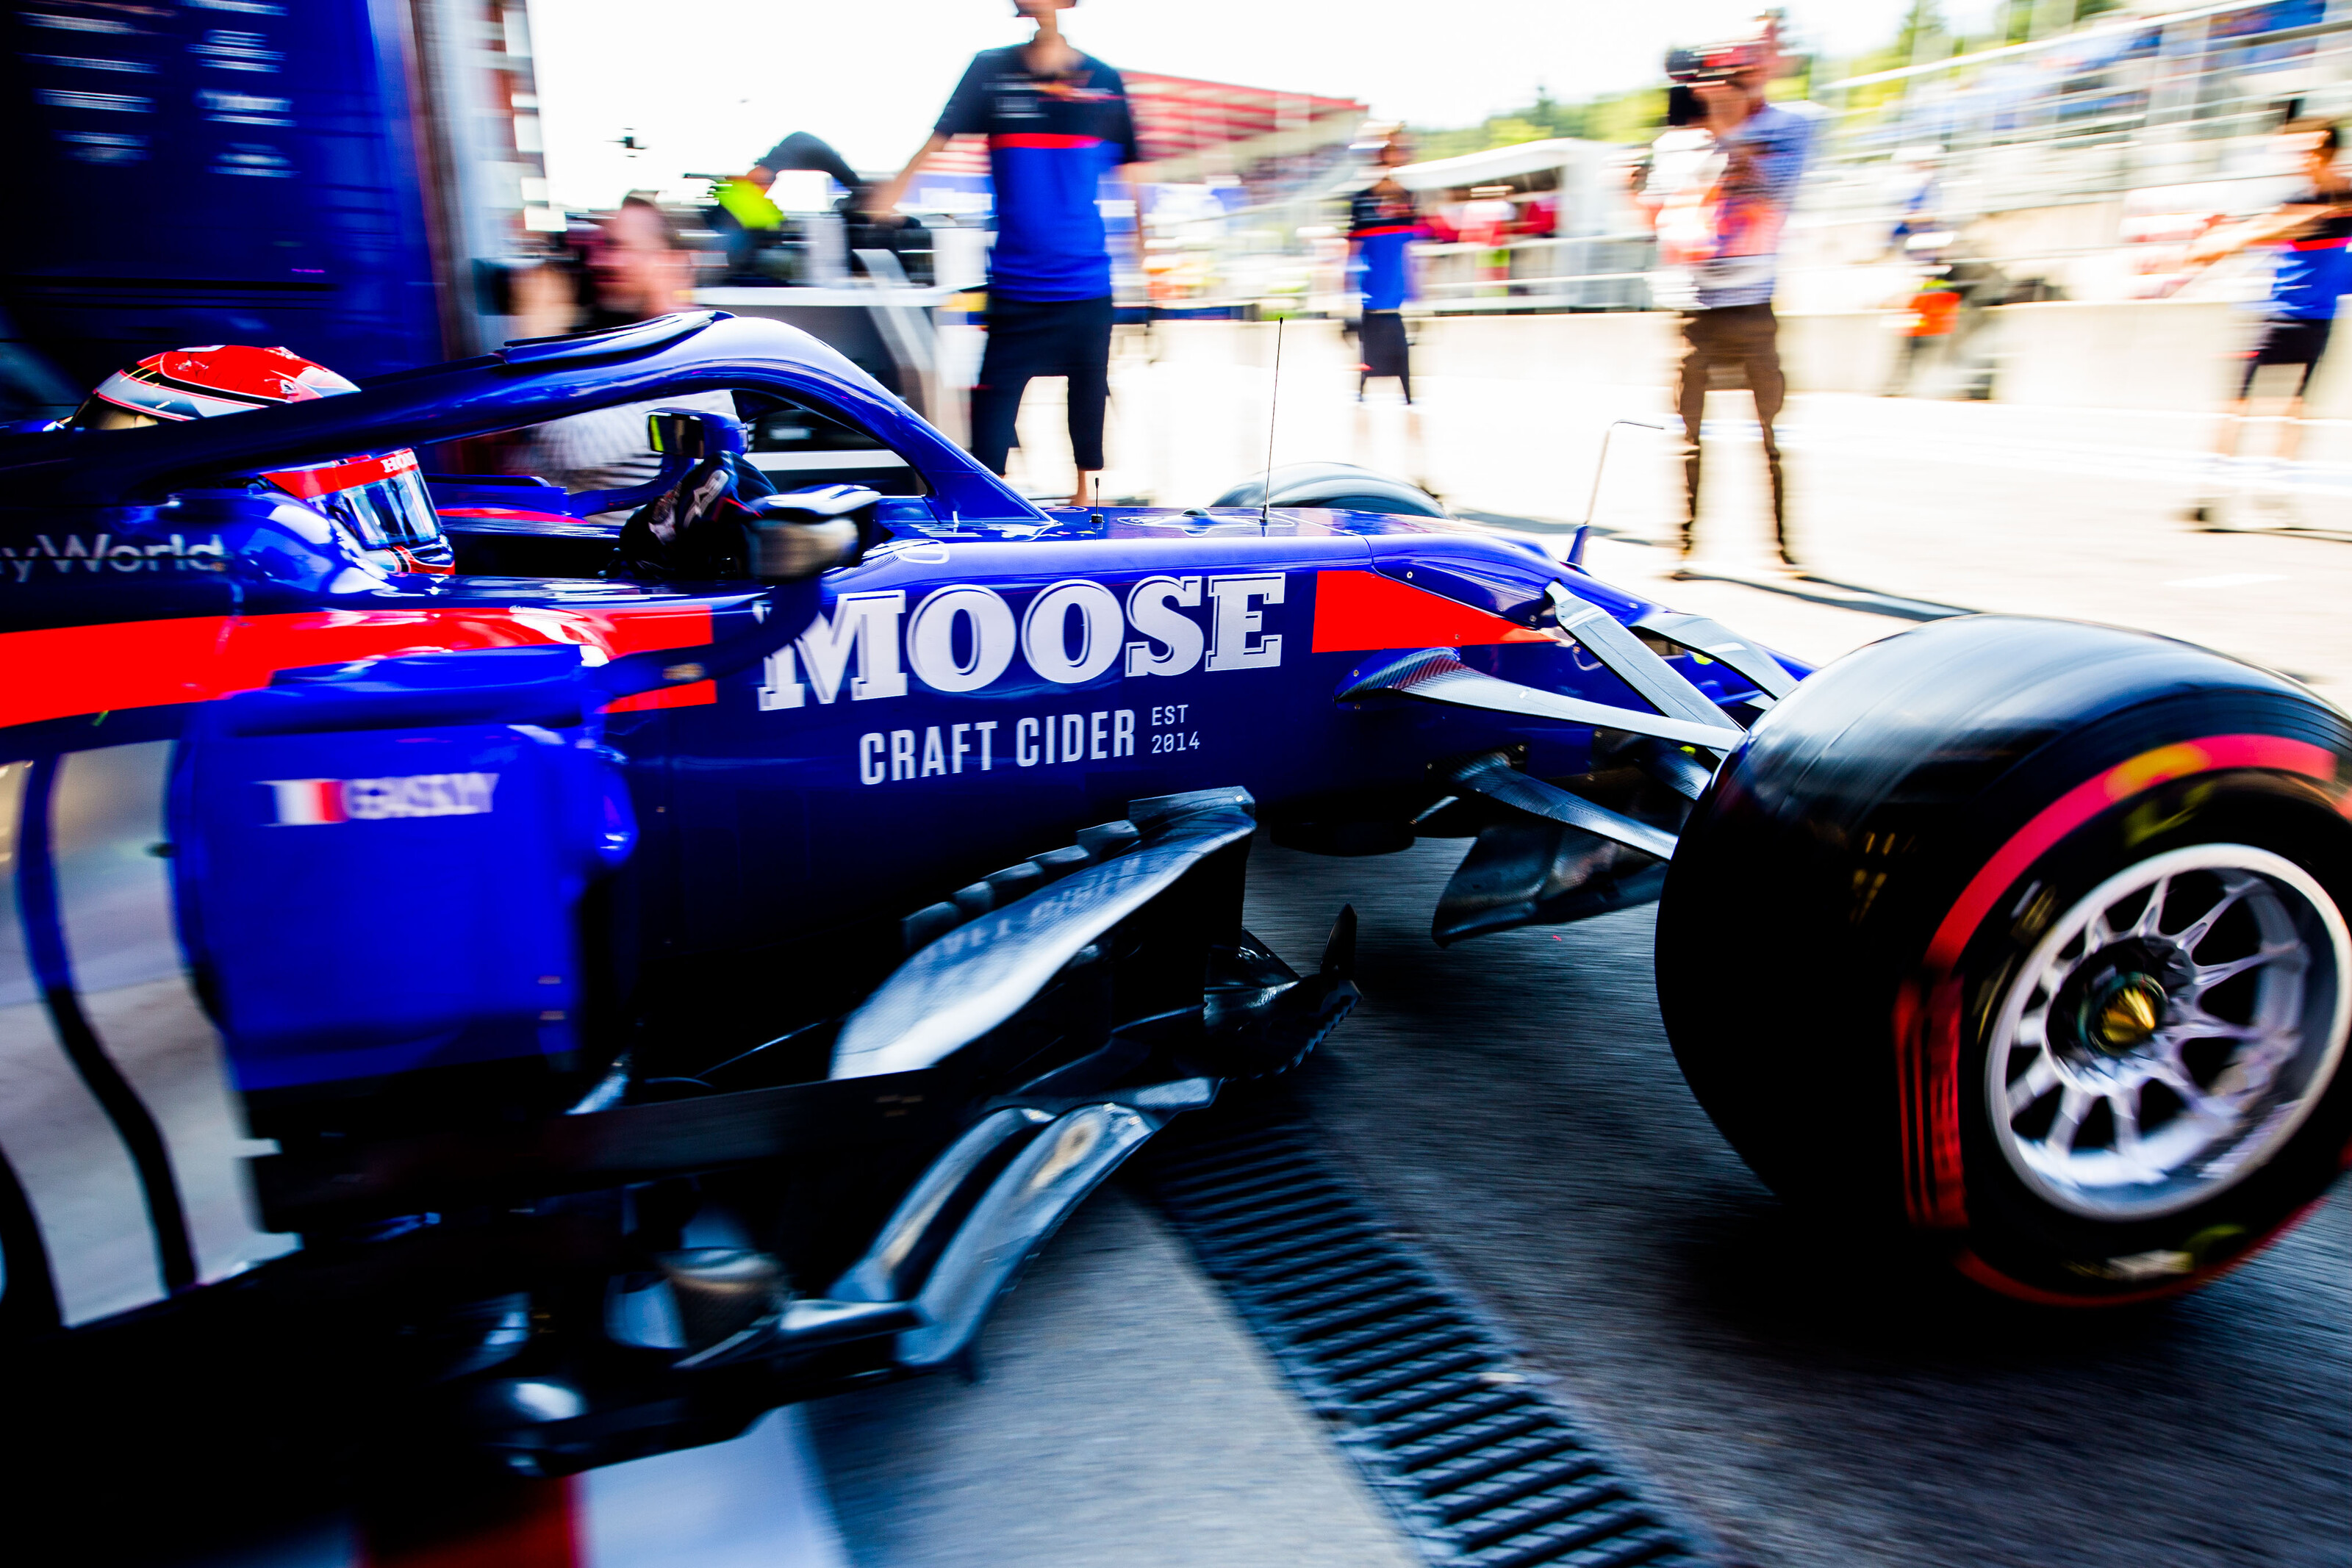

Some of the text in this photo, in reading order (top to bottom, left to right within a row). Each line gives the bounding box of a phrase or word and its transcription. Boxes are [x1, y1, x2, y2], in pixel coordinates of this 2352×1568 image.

[0, 534, 223, 583] yWorld
[757, 572, 1285, 711] MOOSE
[1151, 704, 1189, 726] EST
[859, 709, 1136, 785] CRAFT CIDER
[1151, 731, 1200, 754] 2014
